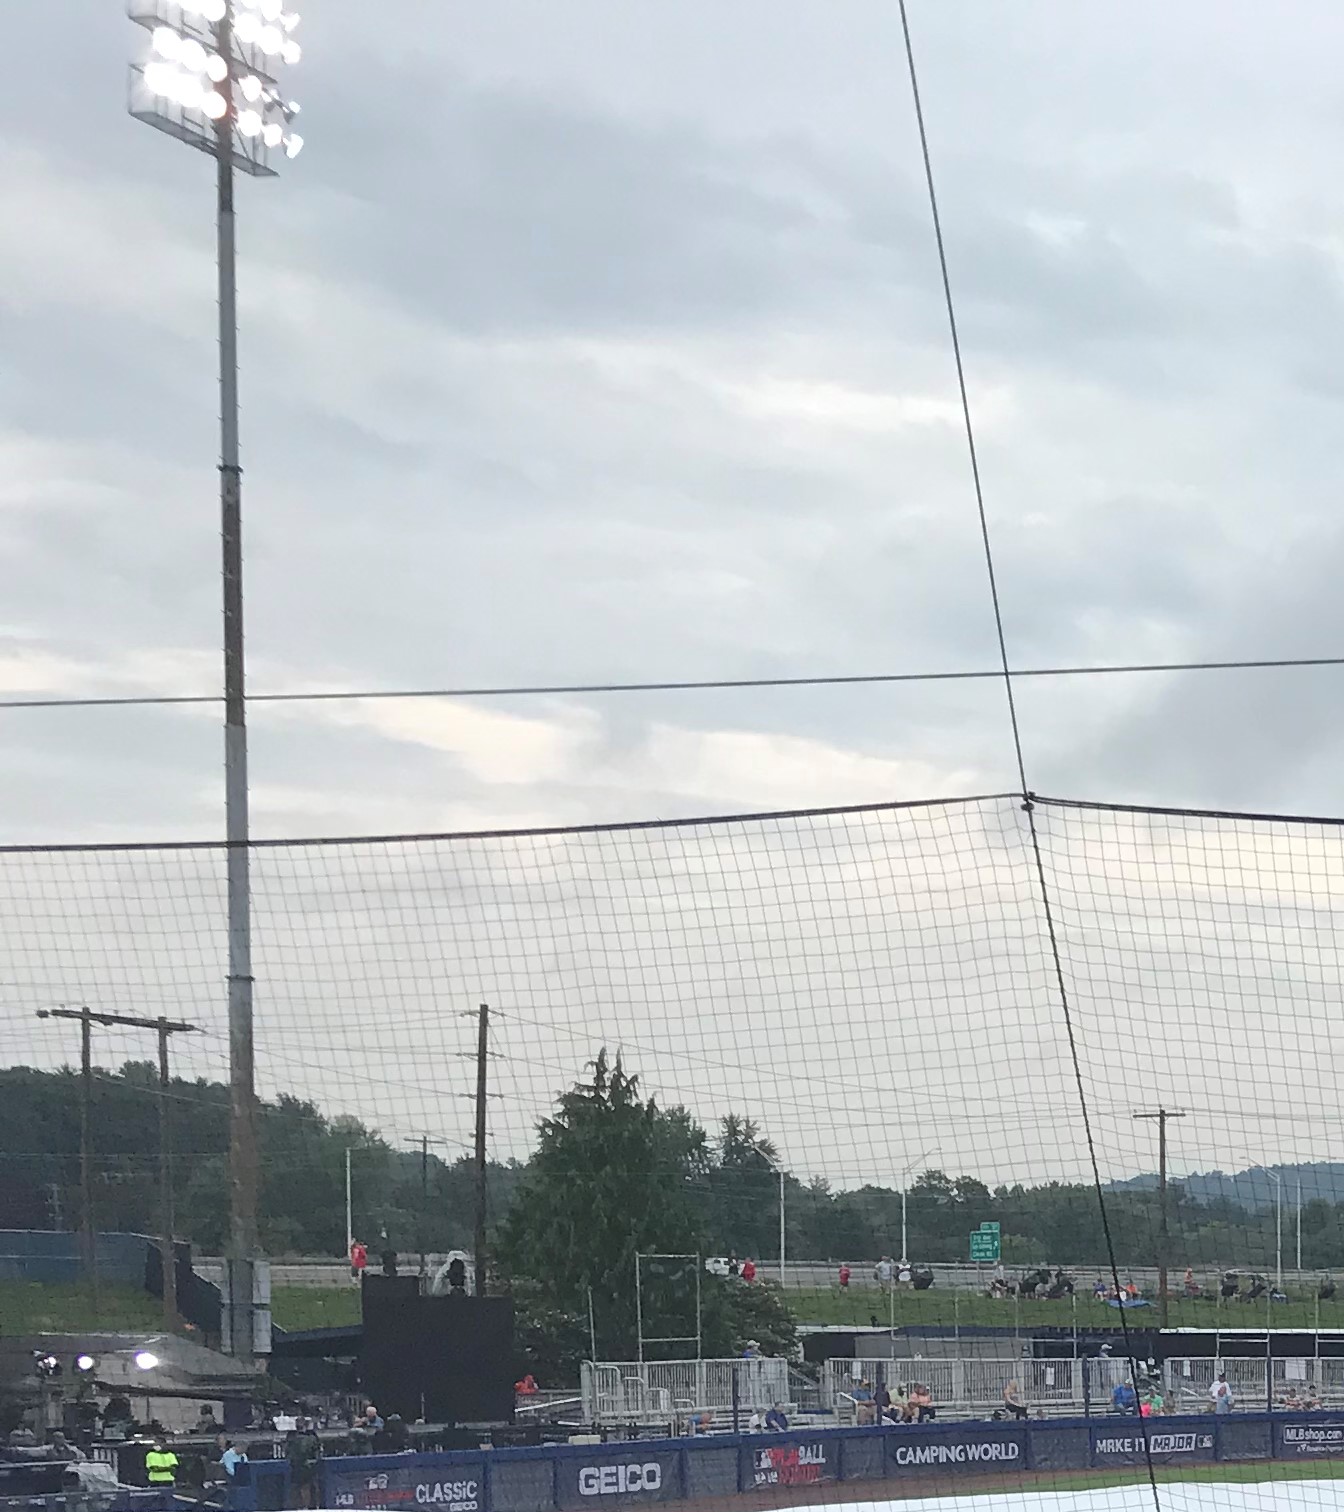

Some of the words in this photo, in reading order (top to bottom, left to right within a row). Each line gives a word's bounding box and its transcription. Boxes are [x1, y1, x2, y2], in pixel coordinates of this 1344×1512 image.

[896, 1445, 966, 1464] CAMPING
[966, 1442, 1019, 1460] WORLD
[1095, 1438, 1132, 1453] MAKE
[1135, 1437, 1146, 1452] IT
[1152, 1434, 1194, 1452] MAJOR
[579, 1462, 661, 1495] GEICO
[450, 1501, 478, 1512] GEICO
